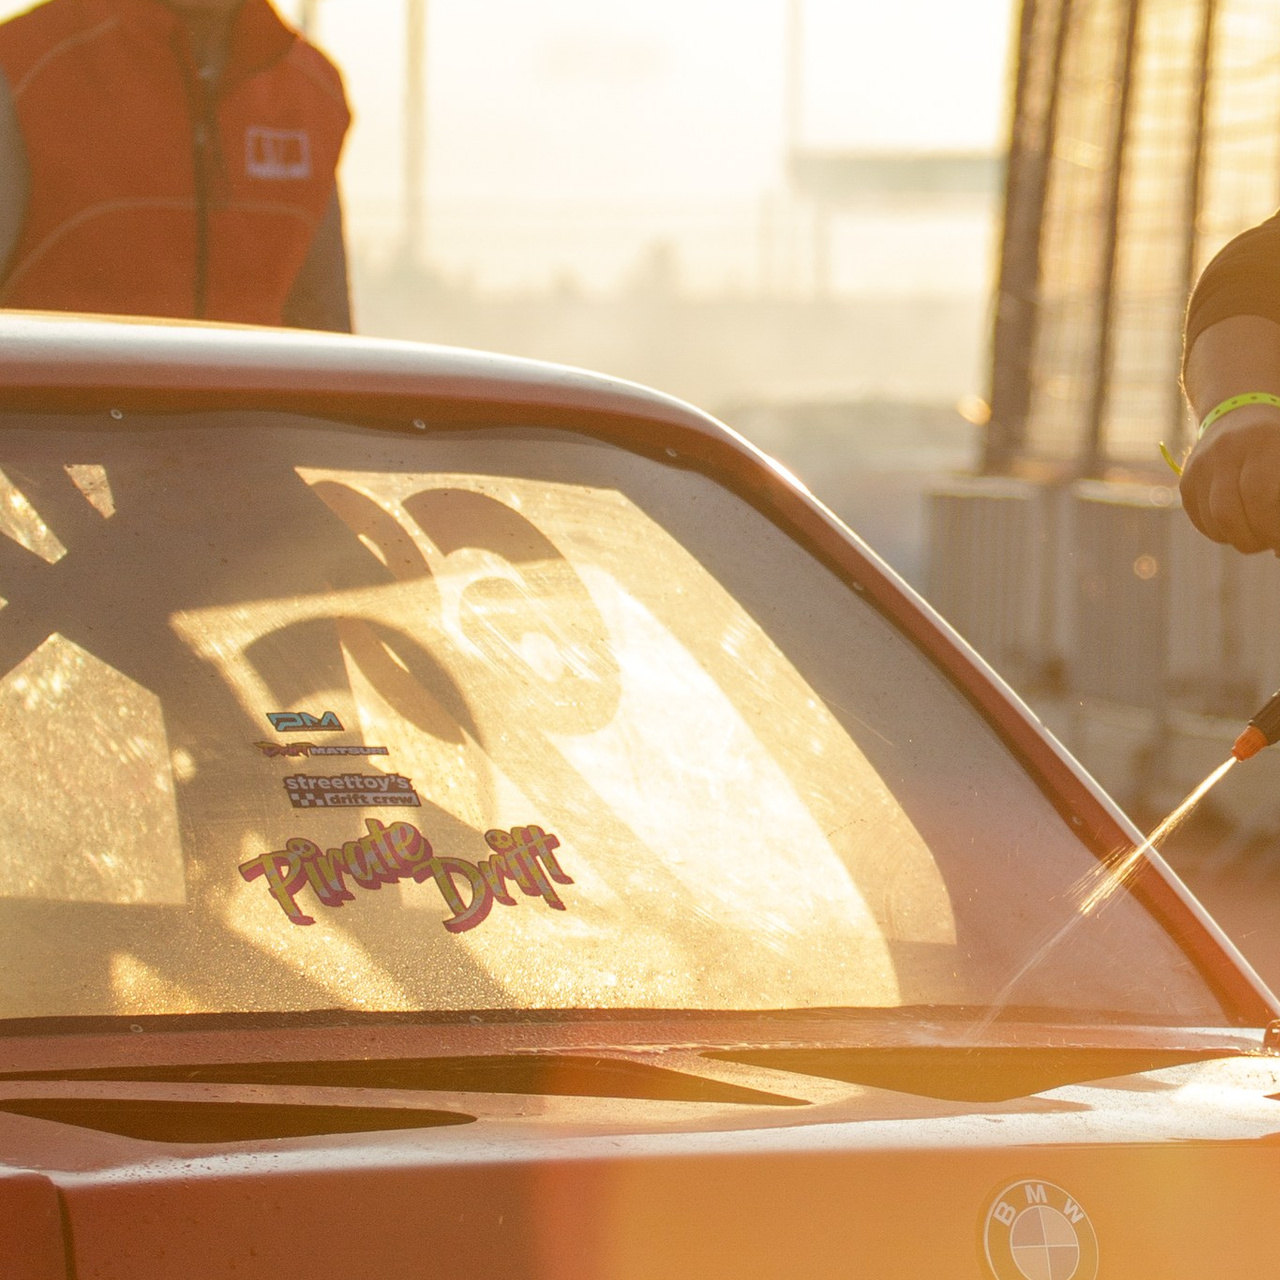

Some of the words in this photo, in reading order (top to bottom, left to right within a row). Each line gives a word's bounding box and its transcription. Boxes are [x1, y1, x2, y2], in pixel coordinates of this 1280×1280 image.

[310, 746, 388, 756] MATSURI
[286, 775, 409, 792] streettoy's
[330, 793, 370, 805] drift
[372, 794, 413, 805] crew
[238, 818, 433, 926] Pirate
[412, 825, 575, 934] Drift
[992, 1184, 1085, 1227] BMW
